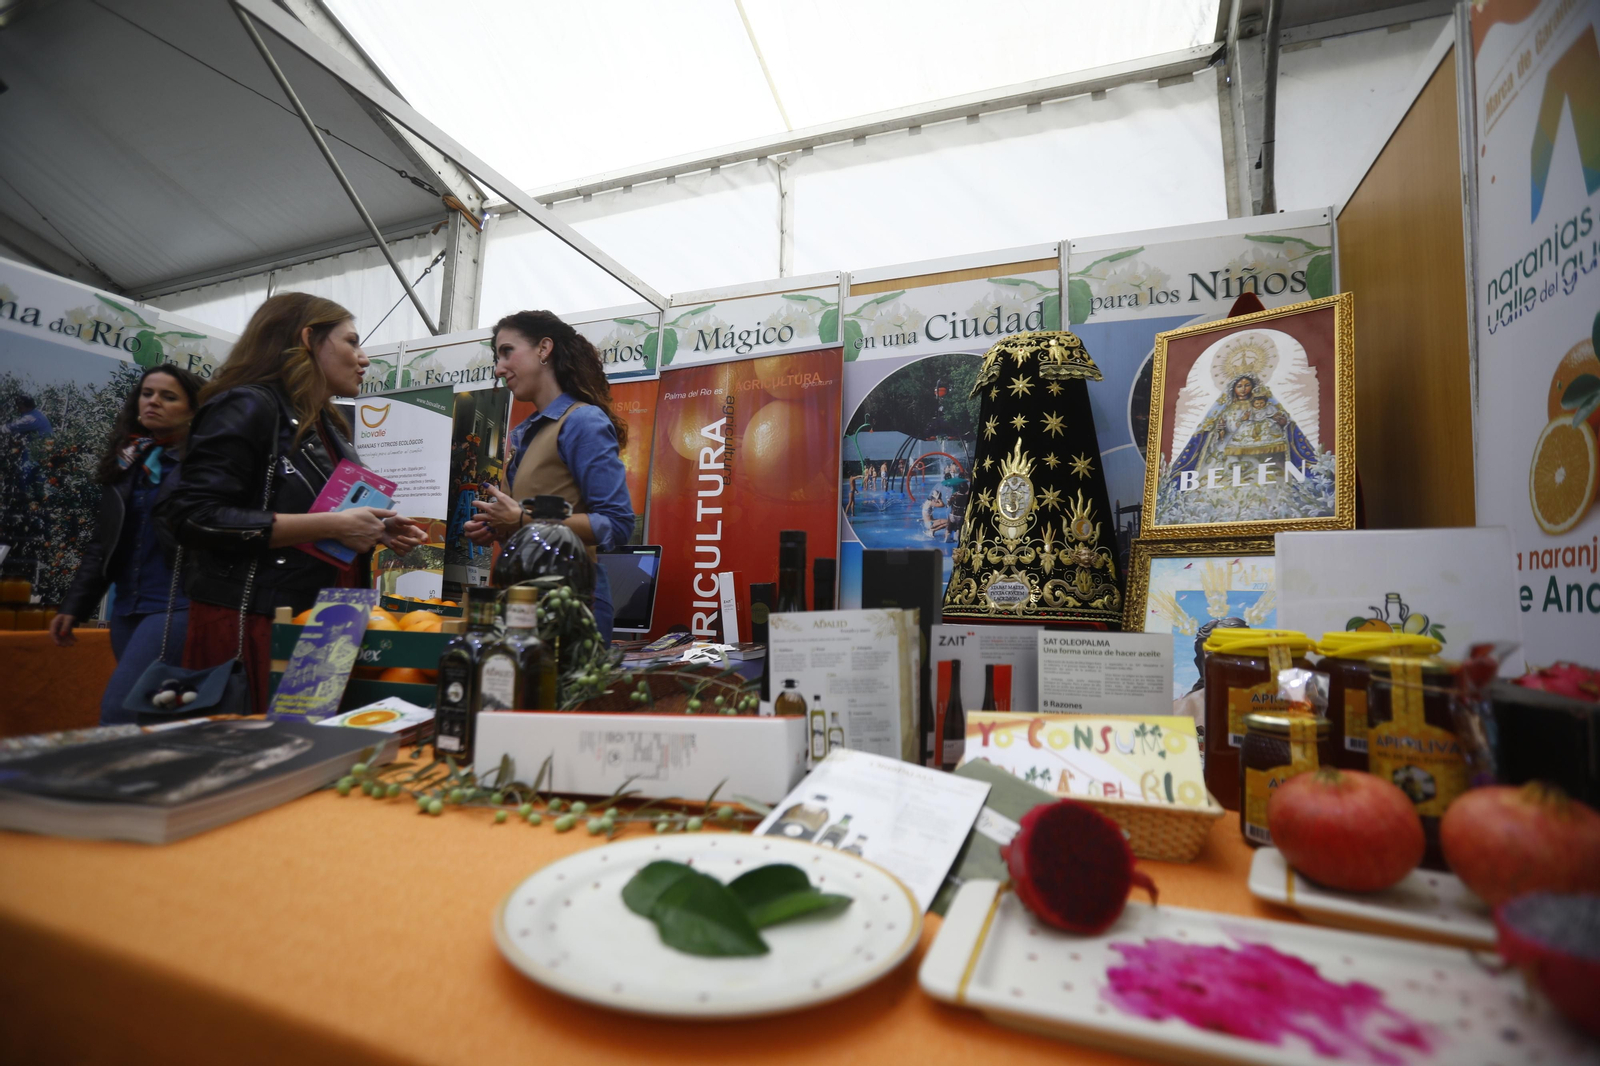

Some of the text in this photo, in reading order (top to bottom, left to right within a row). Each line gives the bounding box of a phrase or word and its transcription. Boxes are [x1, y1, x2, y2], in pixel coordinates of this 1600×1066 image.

[1488, 206, 1592, 305] naranjas
[1090, 267, 1307, 315] para los Niños
[1488, 240, 1600, 335] valle del gu
[49, 318, 82, 338] del
[91, 320, 142, 354] Río
[694, 322, 794, 354] Mágico
[853, 300, 1047, 350] en una Ciudad
[664, 392, 687, 400] Palma
[688, 390, 698, 398] del
[735, 372, 822, 392] AGRICULTURA
[800, 378, 833, 388] agricultura
[722, 394, 736, 486] agricultura
[1180, 456, 1306, 492] BELÉN
[1043, 638, 1058, 646] SAT
[1059, 638, 1110, 647] OLEOPALMA
[1043, 647, 1161, 658] Una forma única de hacer aceite
[1050, 701, 1083, 710] Razones
[978, 718, 1187, 760] YO CONSUMO
